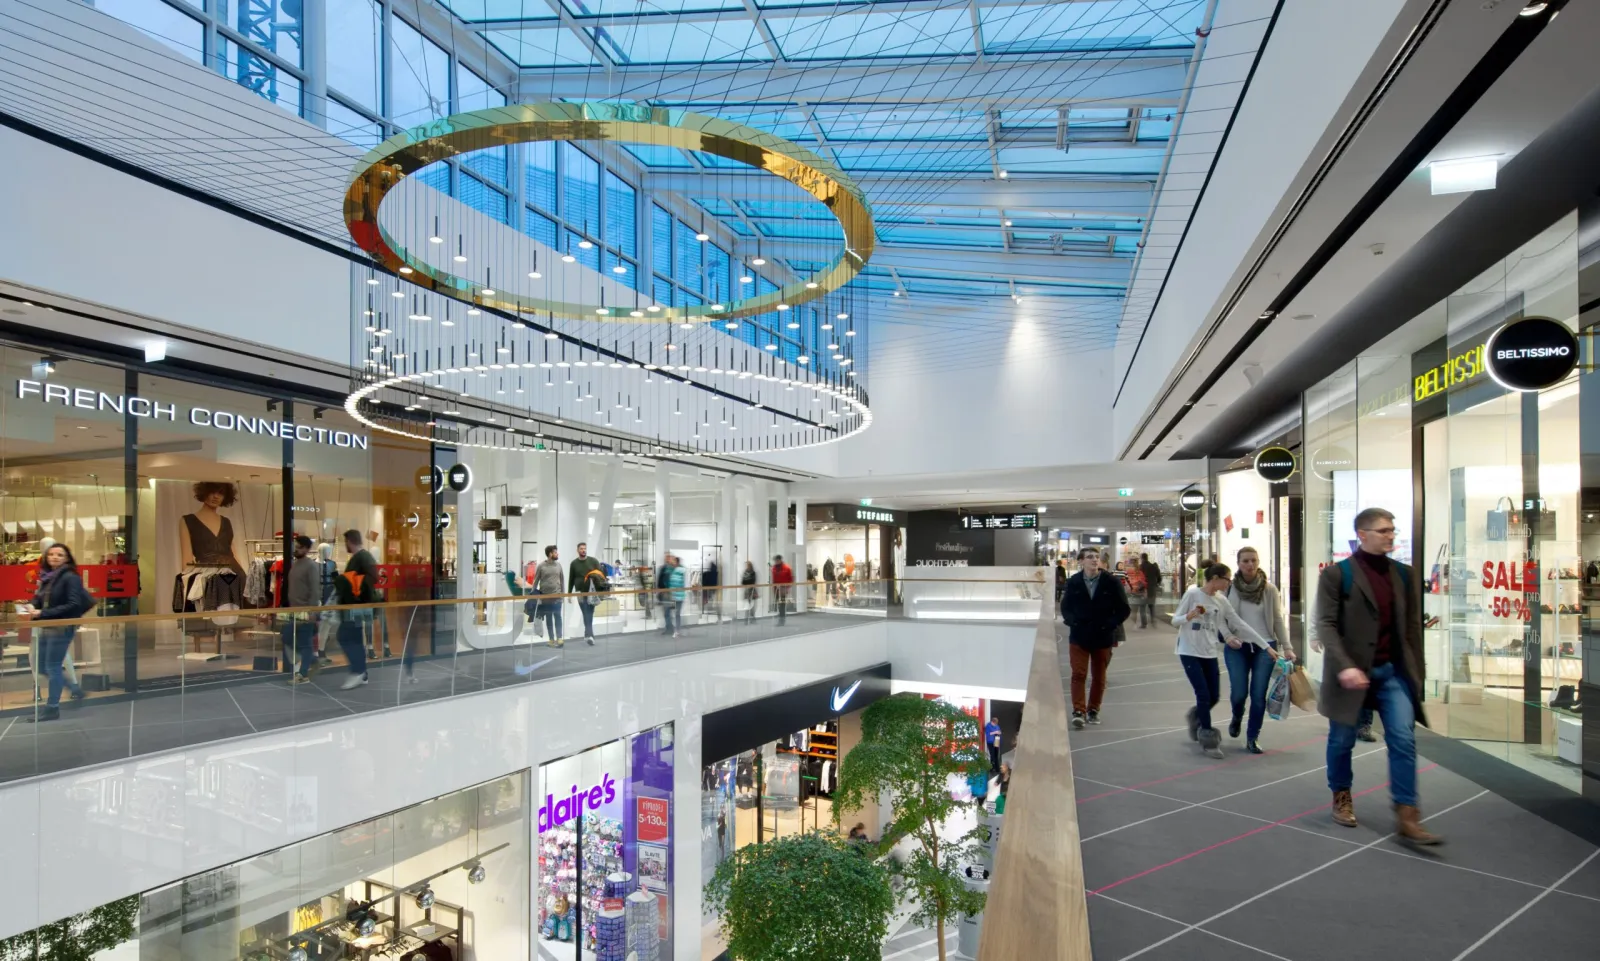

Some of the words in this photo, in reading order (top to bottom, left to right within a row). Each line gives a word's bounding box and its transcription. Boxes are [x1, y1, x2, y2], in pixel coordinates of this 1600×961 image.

[1497, 346, 1570, 360] BELTISSIMO
[16, 379, 175, 422] FRENCH
[190, 407, 368, 450] CONNECTION
[1259, 461, 1293, 469] COCCINELLE
[856, 510, 894, 523] STEFANEL
[962, 516, 969, 529] 1
[25, 569, 125, 595] SLE
[1481, 560, 1538, 592] SALE
